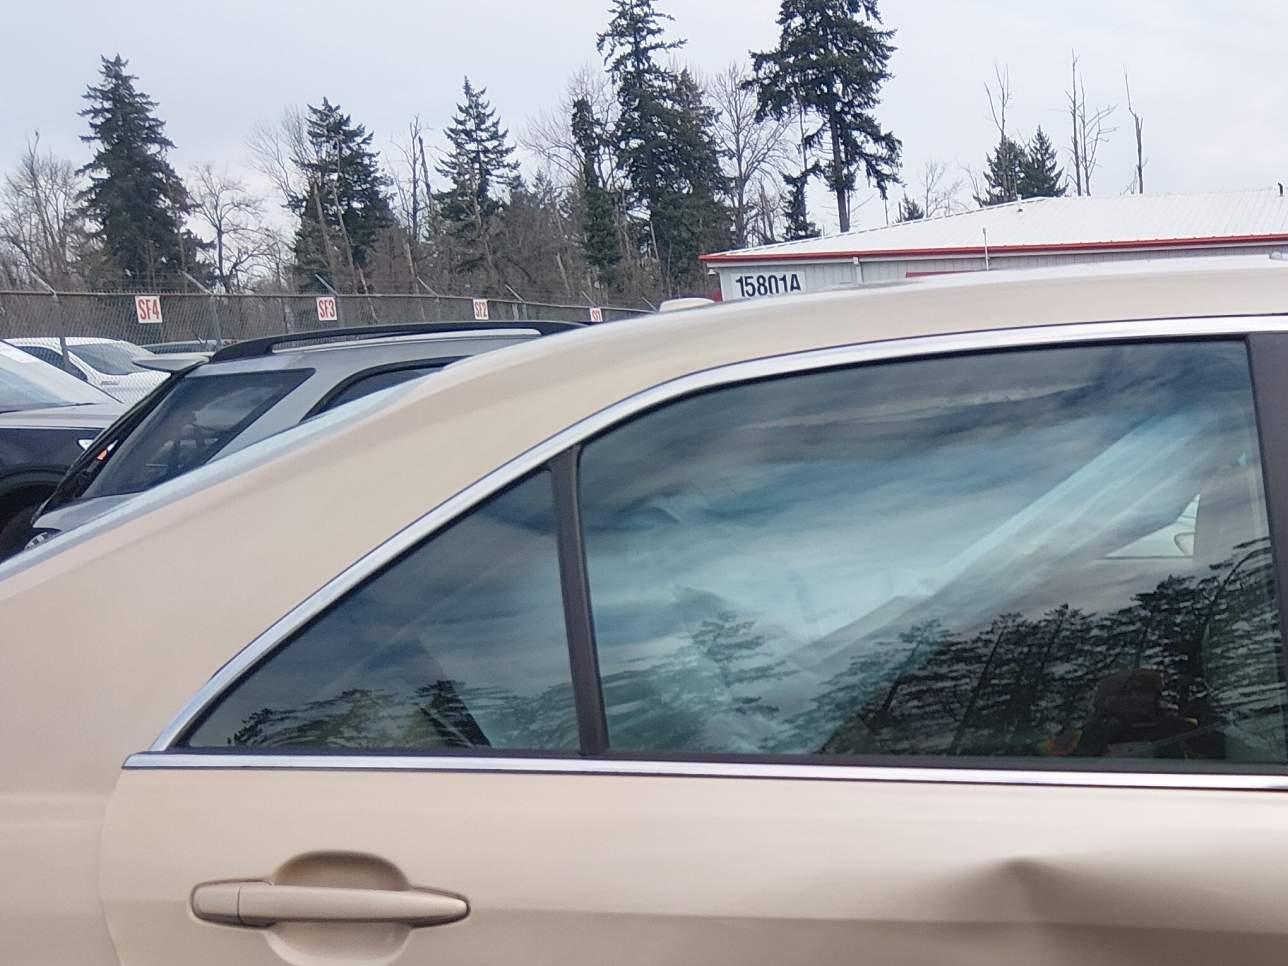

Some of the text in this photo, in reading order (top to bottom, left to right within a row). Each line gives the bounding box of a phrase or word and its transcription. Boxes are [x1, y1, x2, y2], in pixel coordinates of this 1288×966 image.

[736, 273, 801, 297] 15801A
[138, 298, 160, 320] SF4
[319, 297, 336, 318] SF3
[474, 301, 488, 318] SF2
